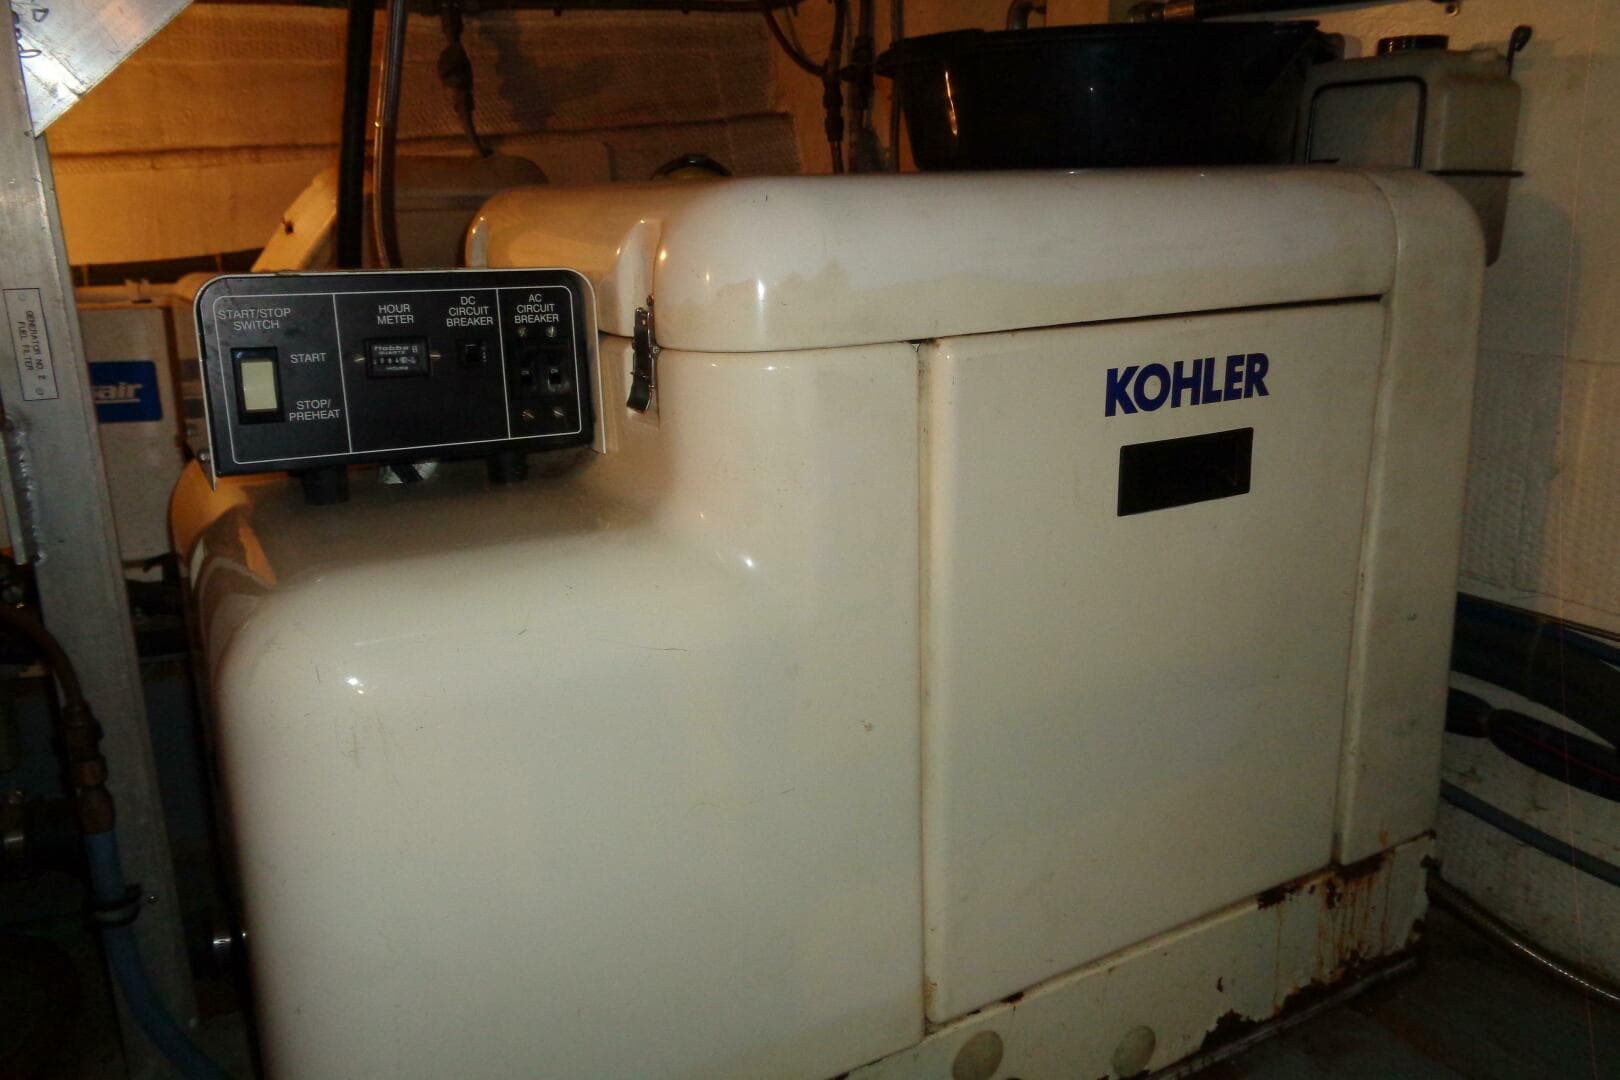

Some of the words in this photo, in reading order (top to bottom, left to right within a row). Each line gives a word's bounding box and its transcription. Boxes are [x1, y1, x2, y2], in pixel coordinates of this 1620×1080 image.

[460, 296, 476, 305] DC
[528, 293, 543, 303] AC
[217, 308, 291, 320] START/STOP
[378, 304, 411, 314] HOUR
[448, 306, 489, 317] CIRCUIT
[516, 303, 555, 314] CIRCUIT
[377, 314, 414, 325] METER
[446, 316, 494, 327] BREAKER
[514, 313, 559, 324] BREAKER
[233, 320, 280, 331] SWITCH
[290, 352, 327, 363] START
[1105, 353, 1269, 417] KOHLER
[296, 399, 332, 410] STOP/
[289, 409, 341, 422] PREHEAT
